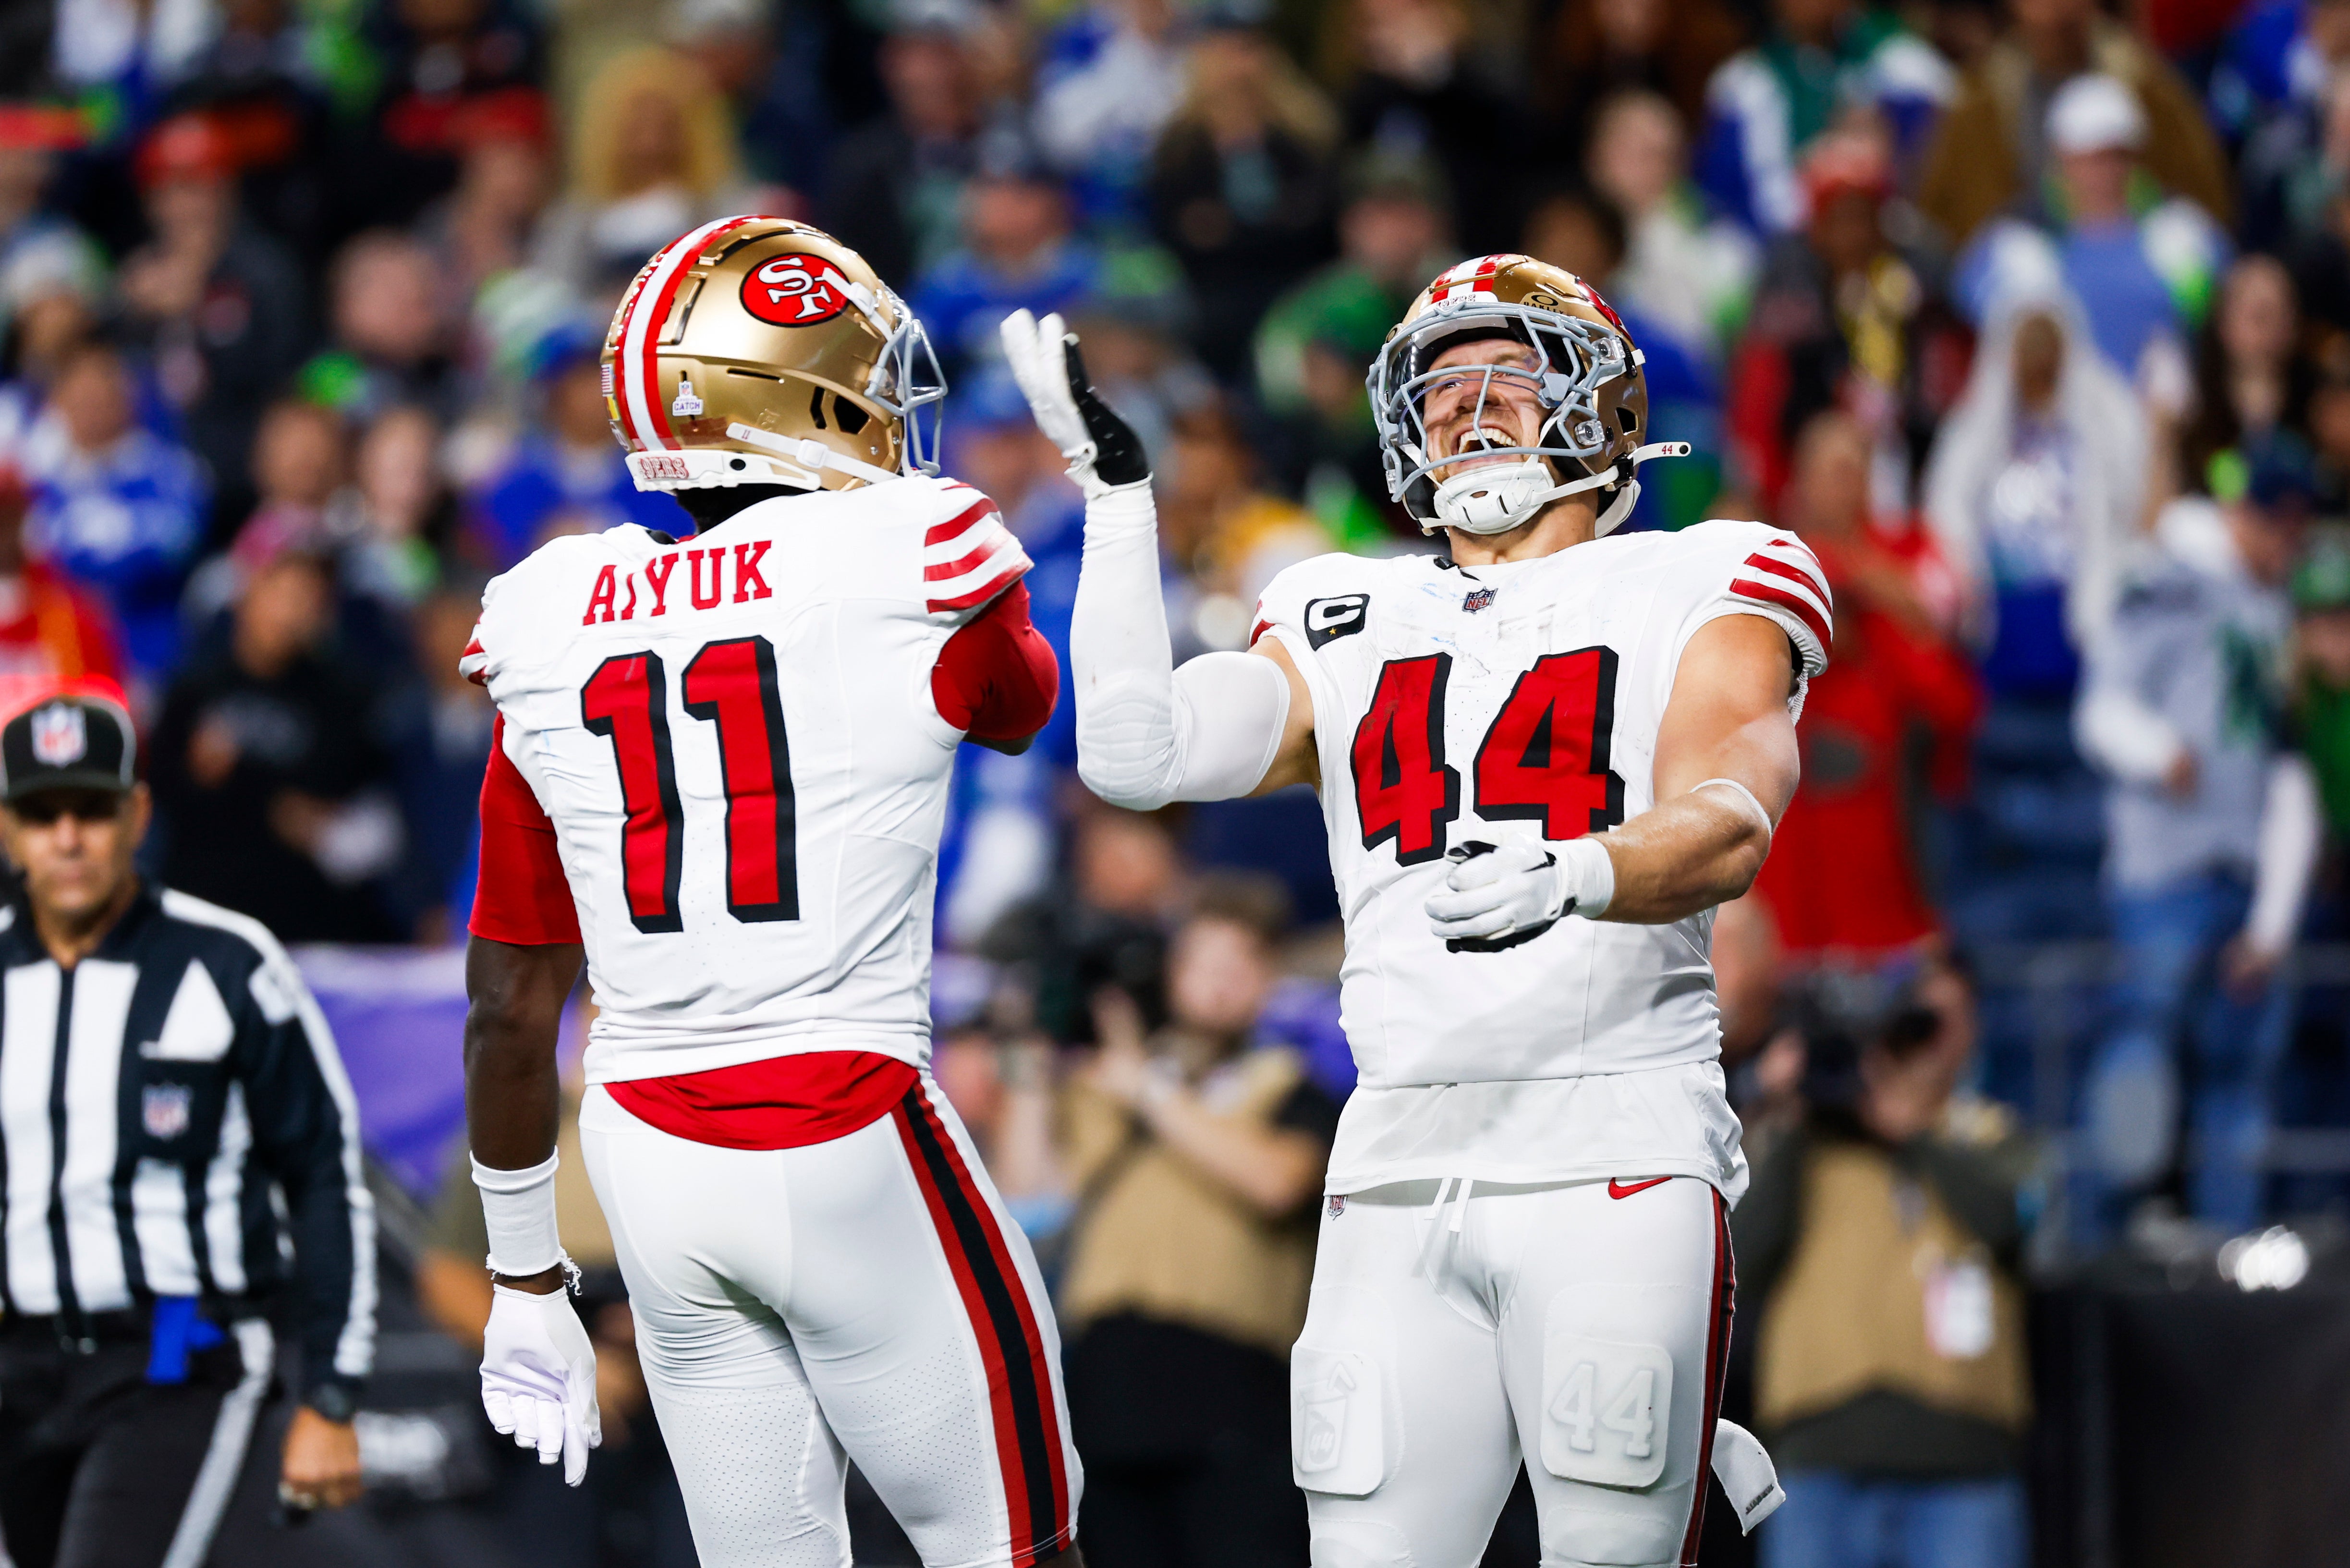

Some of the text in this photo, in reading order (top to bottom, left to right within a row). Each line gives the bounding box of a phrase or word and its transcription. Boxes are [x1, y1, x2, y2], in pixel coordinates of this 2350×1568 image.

[674, 401, 700, 411] CATCH
[1661, 444, 1673, 455] 44
[583, 540, 772, 626] AIYUK
[1308, 596, 1364, 632] C
[580, 634, 800, 934] 11
[1350, 644, 1626, 867] 44
[1547, 1363, 1654, 1457] 44
